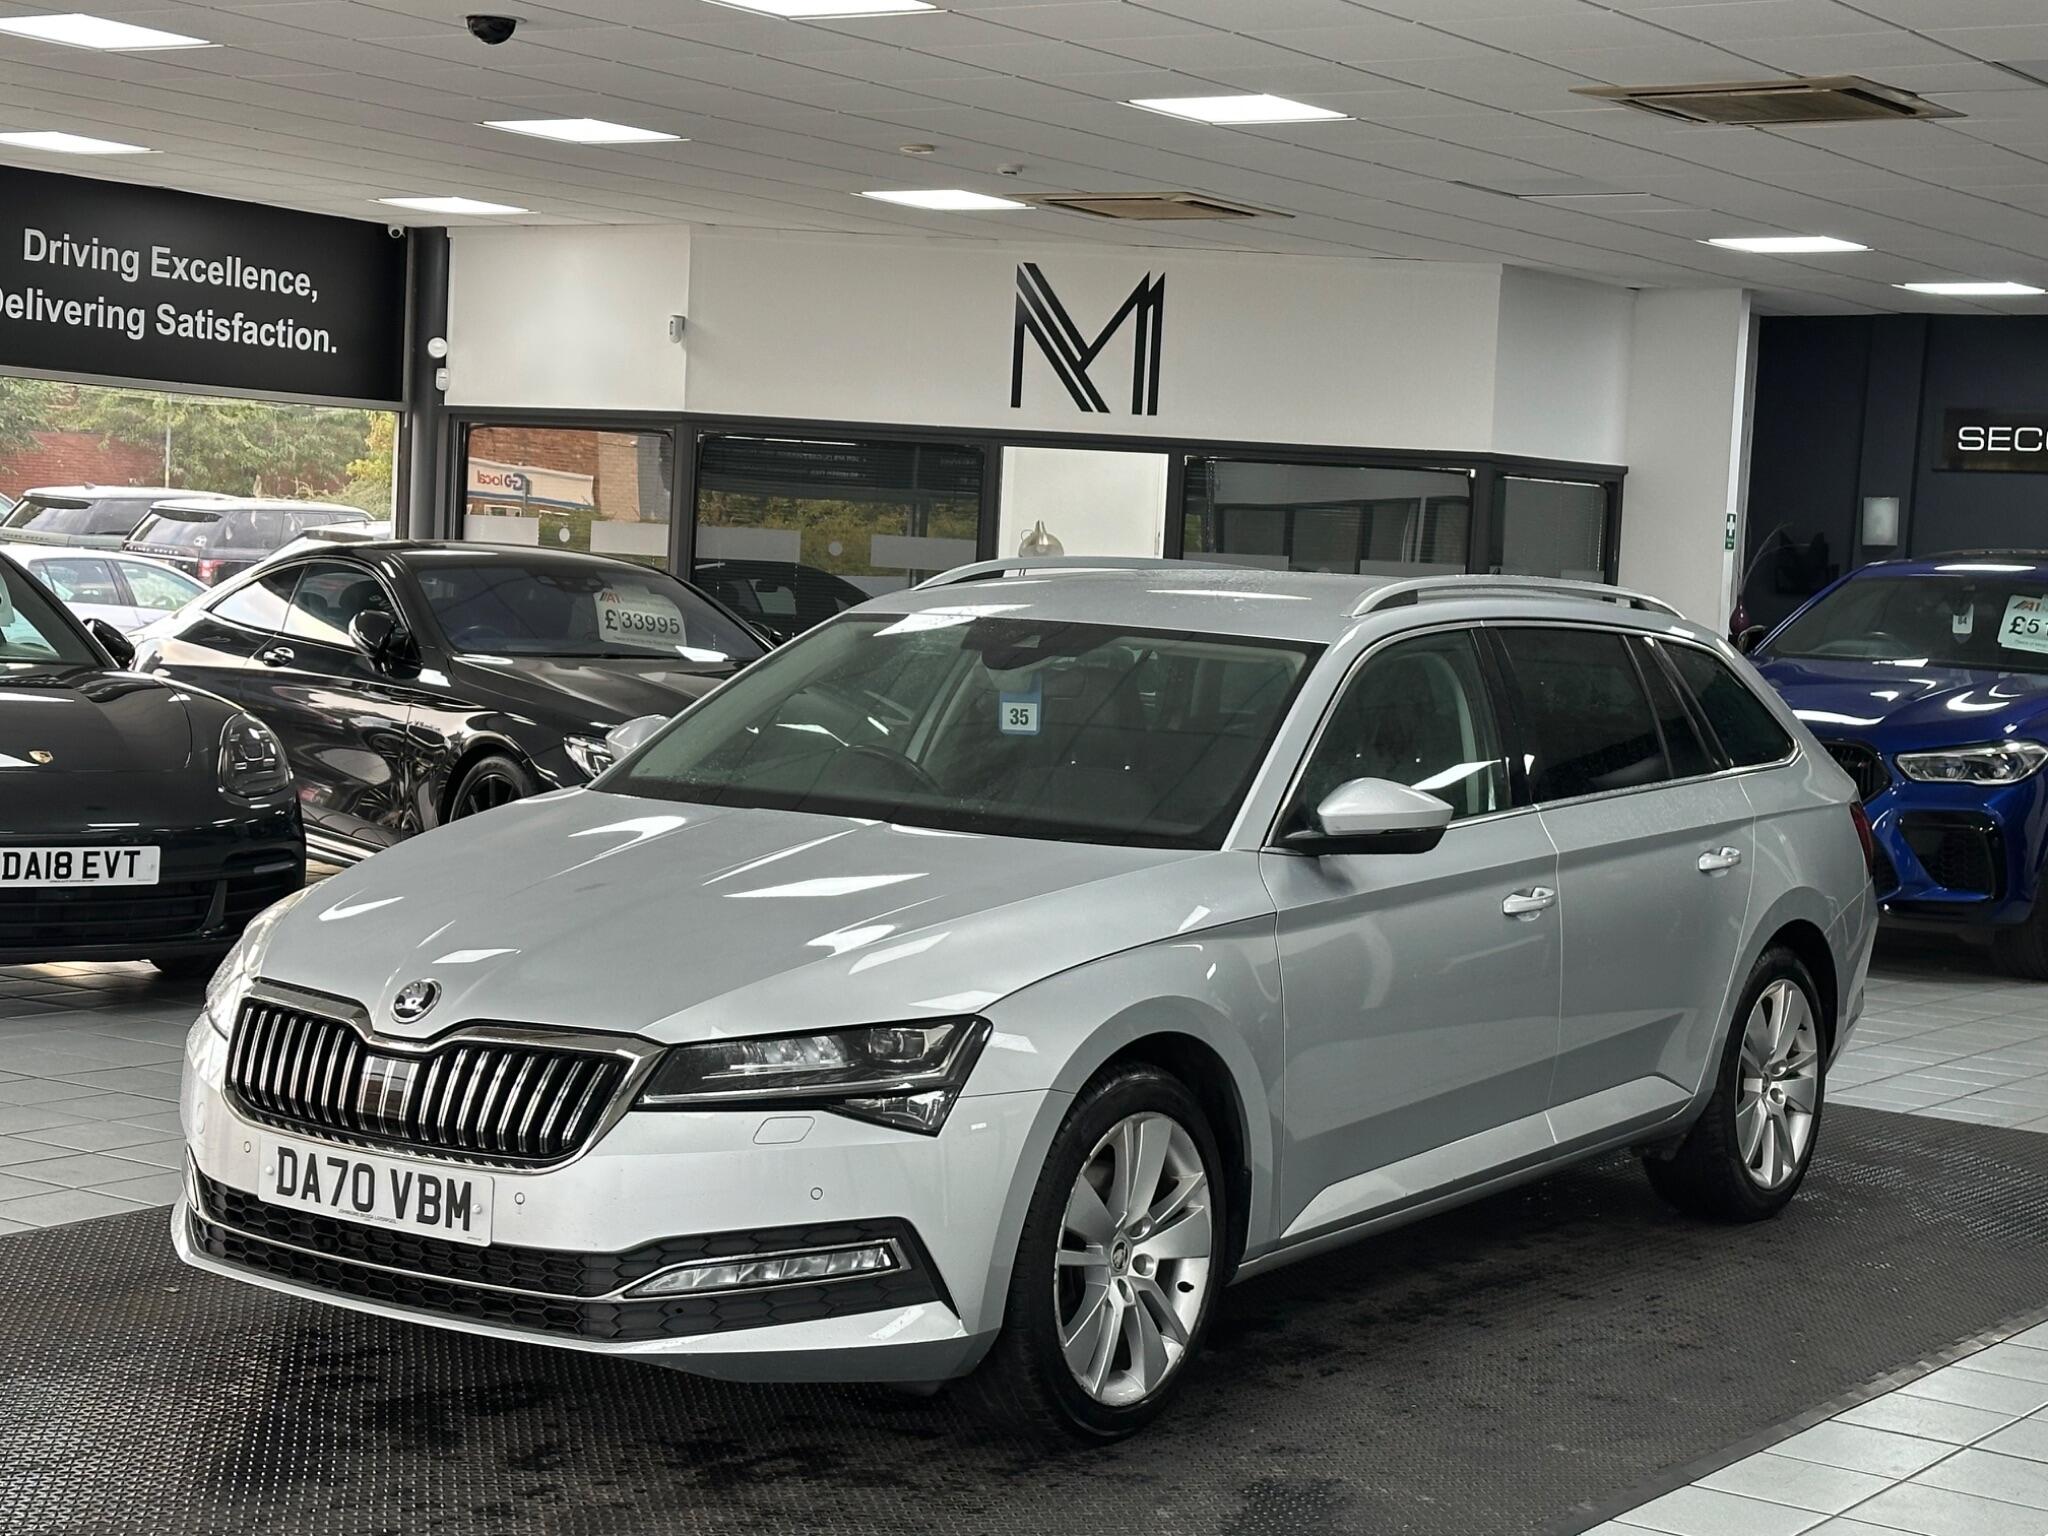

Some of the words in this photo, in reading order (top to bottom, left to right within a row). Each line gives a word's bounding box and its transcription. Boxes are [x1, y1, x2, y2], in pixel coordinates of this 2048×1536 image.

[23, 228, 140, 282] Driving
[151, 246, 319, 303] Excellence,
[0, 287, 145, 340] elivering
[155, 303, 338, 353] Satisfaction.
[1957, 426, 2048, 452] SEC
[605, 609, 680, 634] £33995
[2008, 616, 2048, 637] £5
[1010, 708, 1029, 725] 35
[2, 851, 73, 880] DA18
[82, 850, 141, 878] EVT
[276, 1146, 375, 1213] DA70
[390, 1168, 472, 1231] VBM
